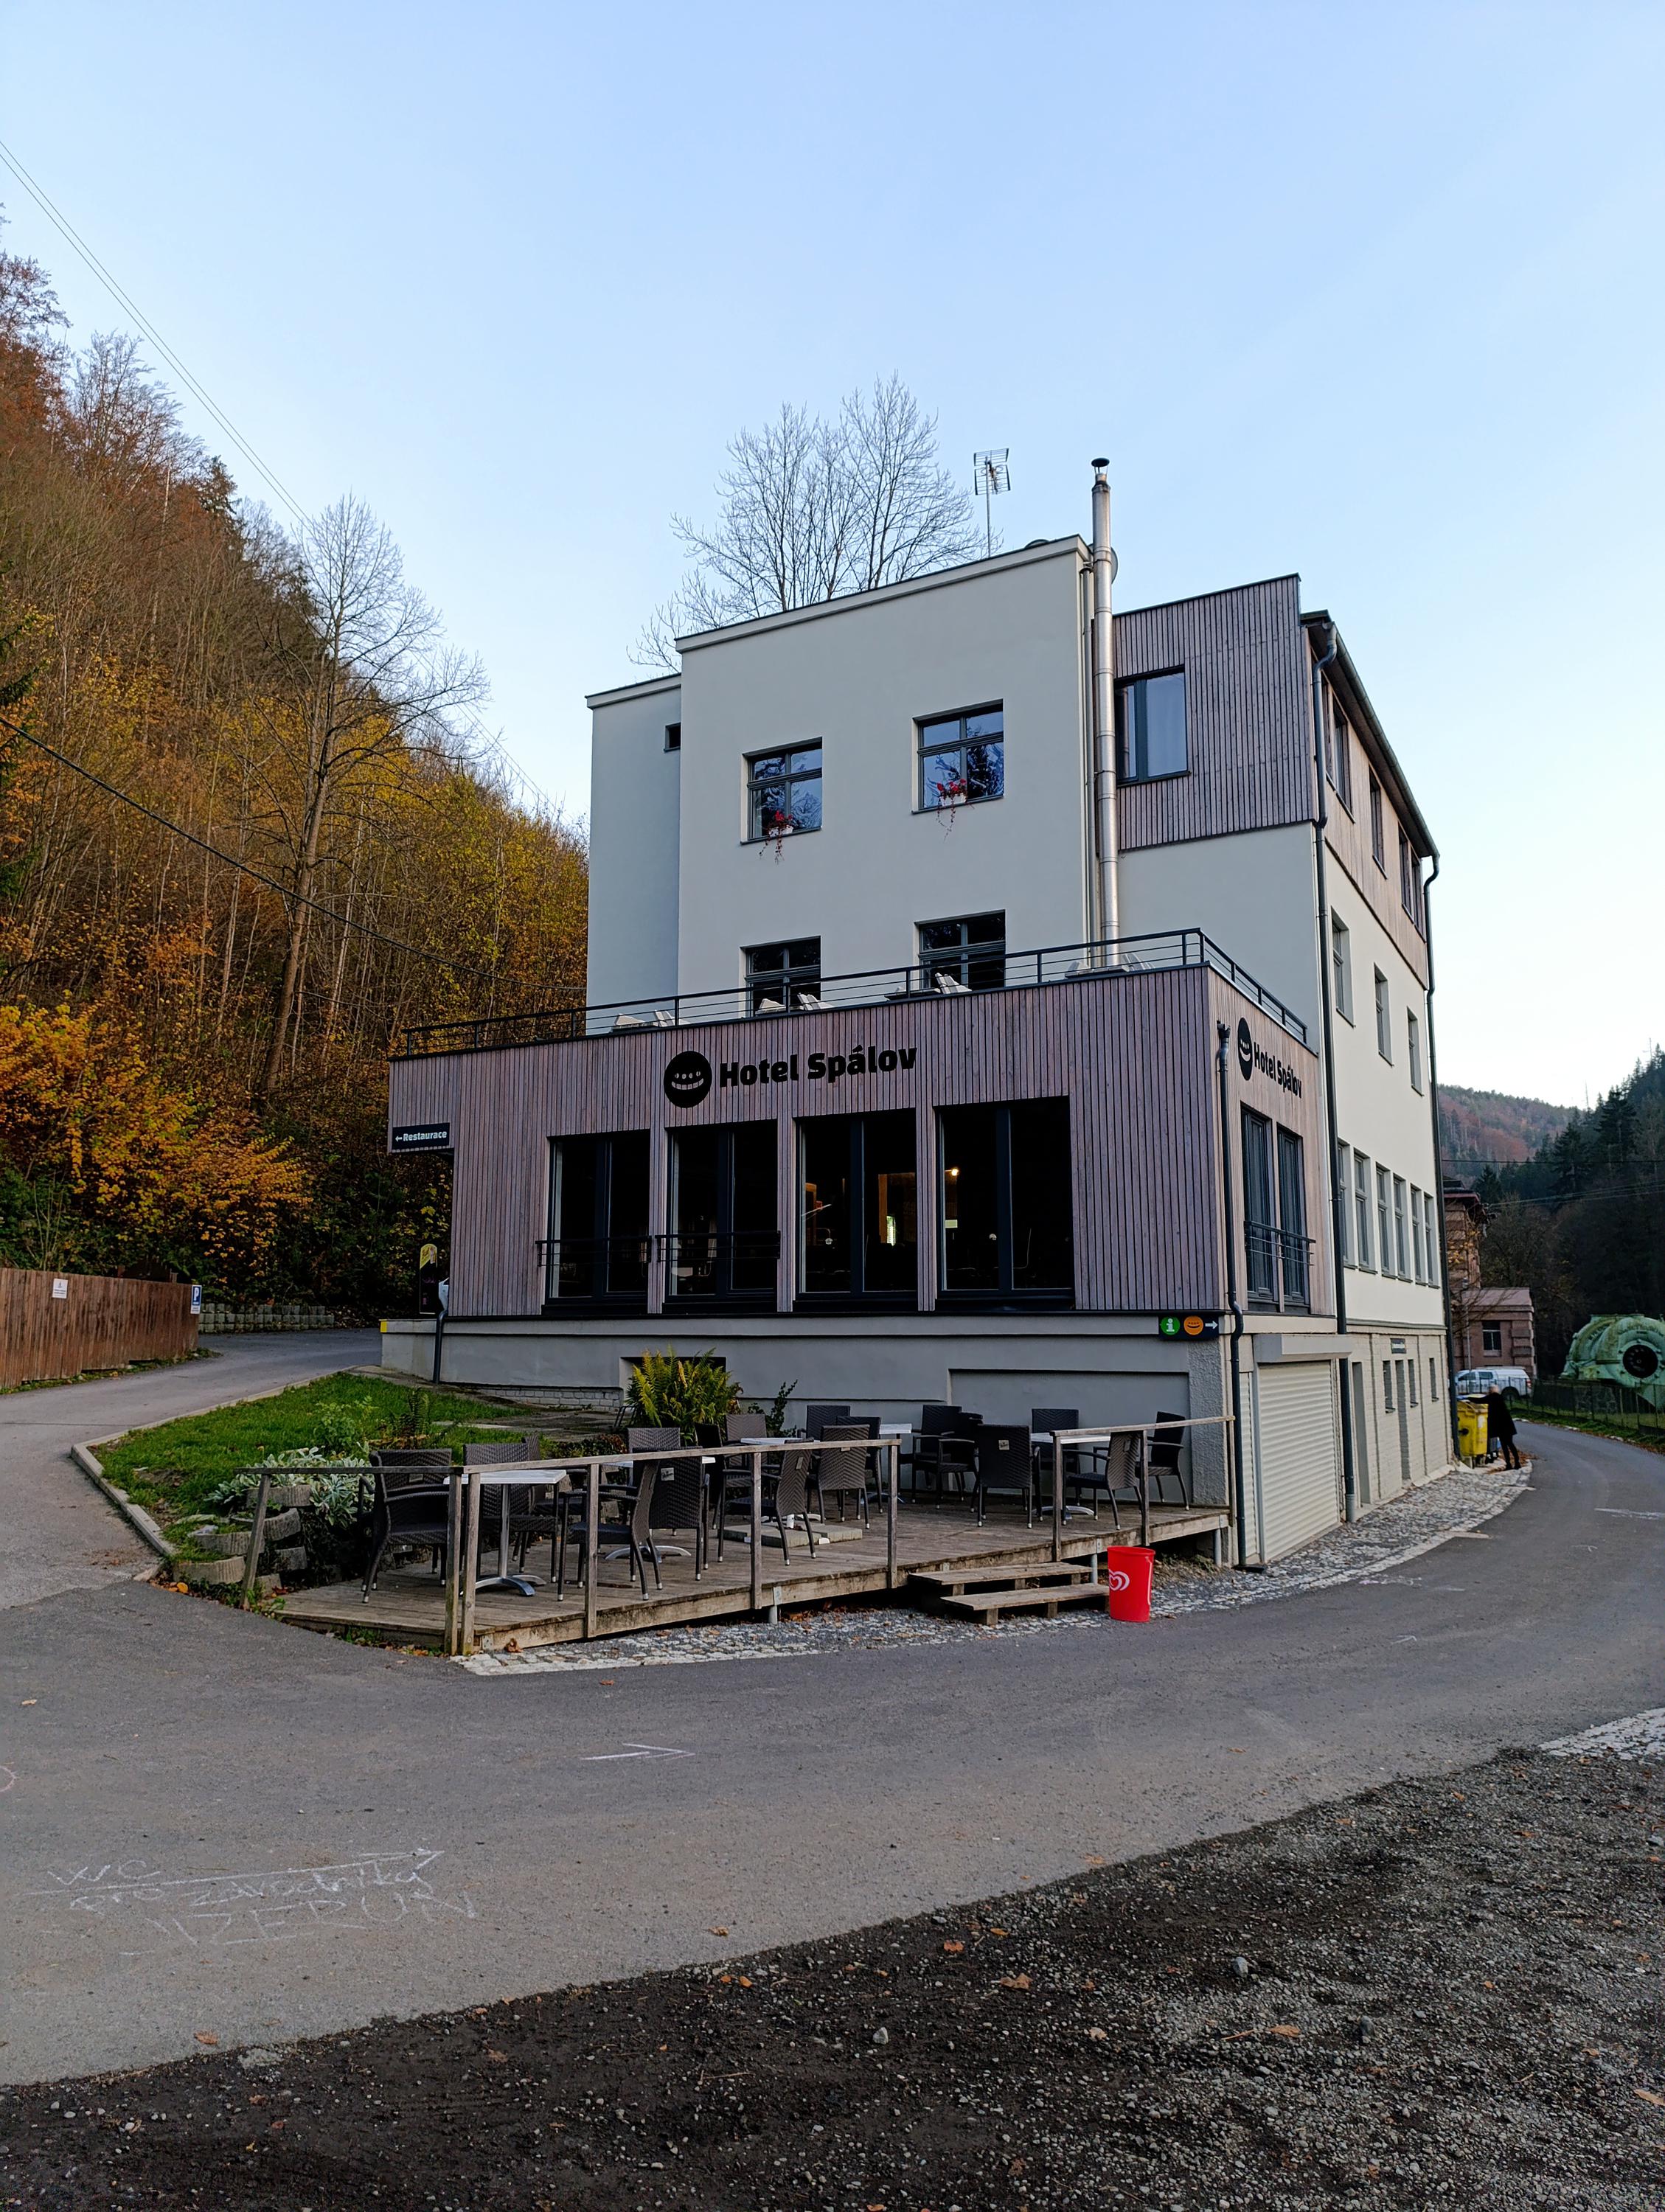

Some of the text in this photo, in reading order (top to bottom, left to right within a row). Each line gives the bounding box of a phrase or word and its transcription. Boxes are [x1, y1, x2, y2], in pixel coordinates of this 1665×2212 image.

[719, 1044, 917, 1088] Hotel Spálov
[1254, 1041, 1302, 1099] Hotel Spálov
[403, 1131, 448, 1142] Restaurace
[194, 1287, 200, 1301] P
